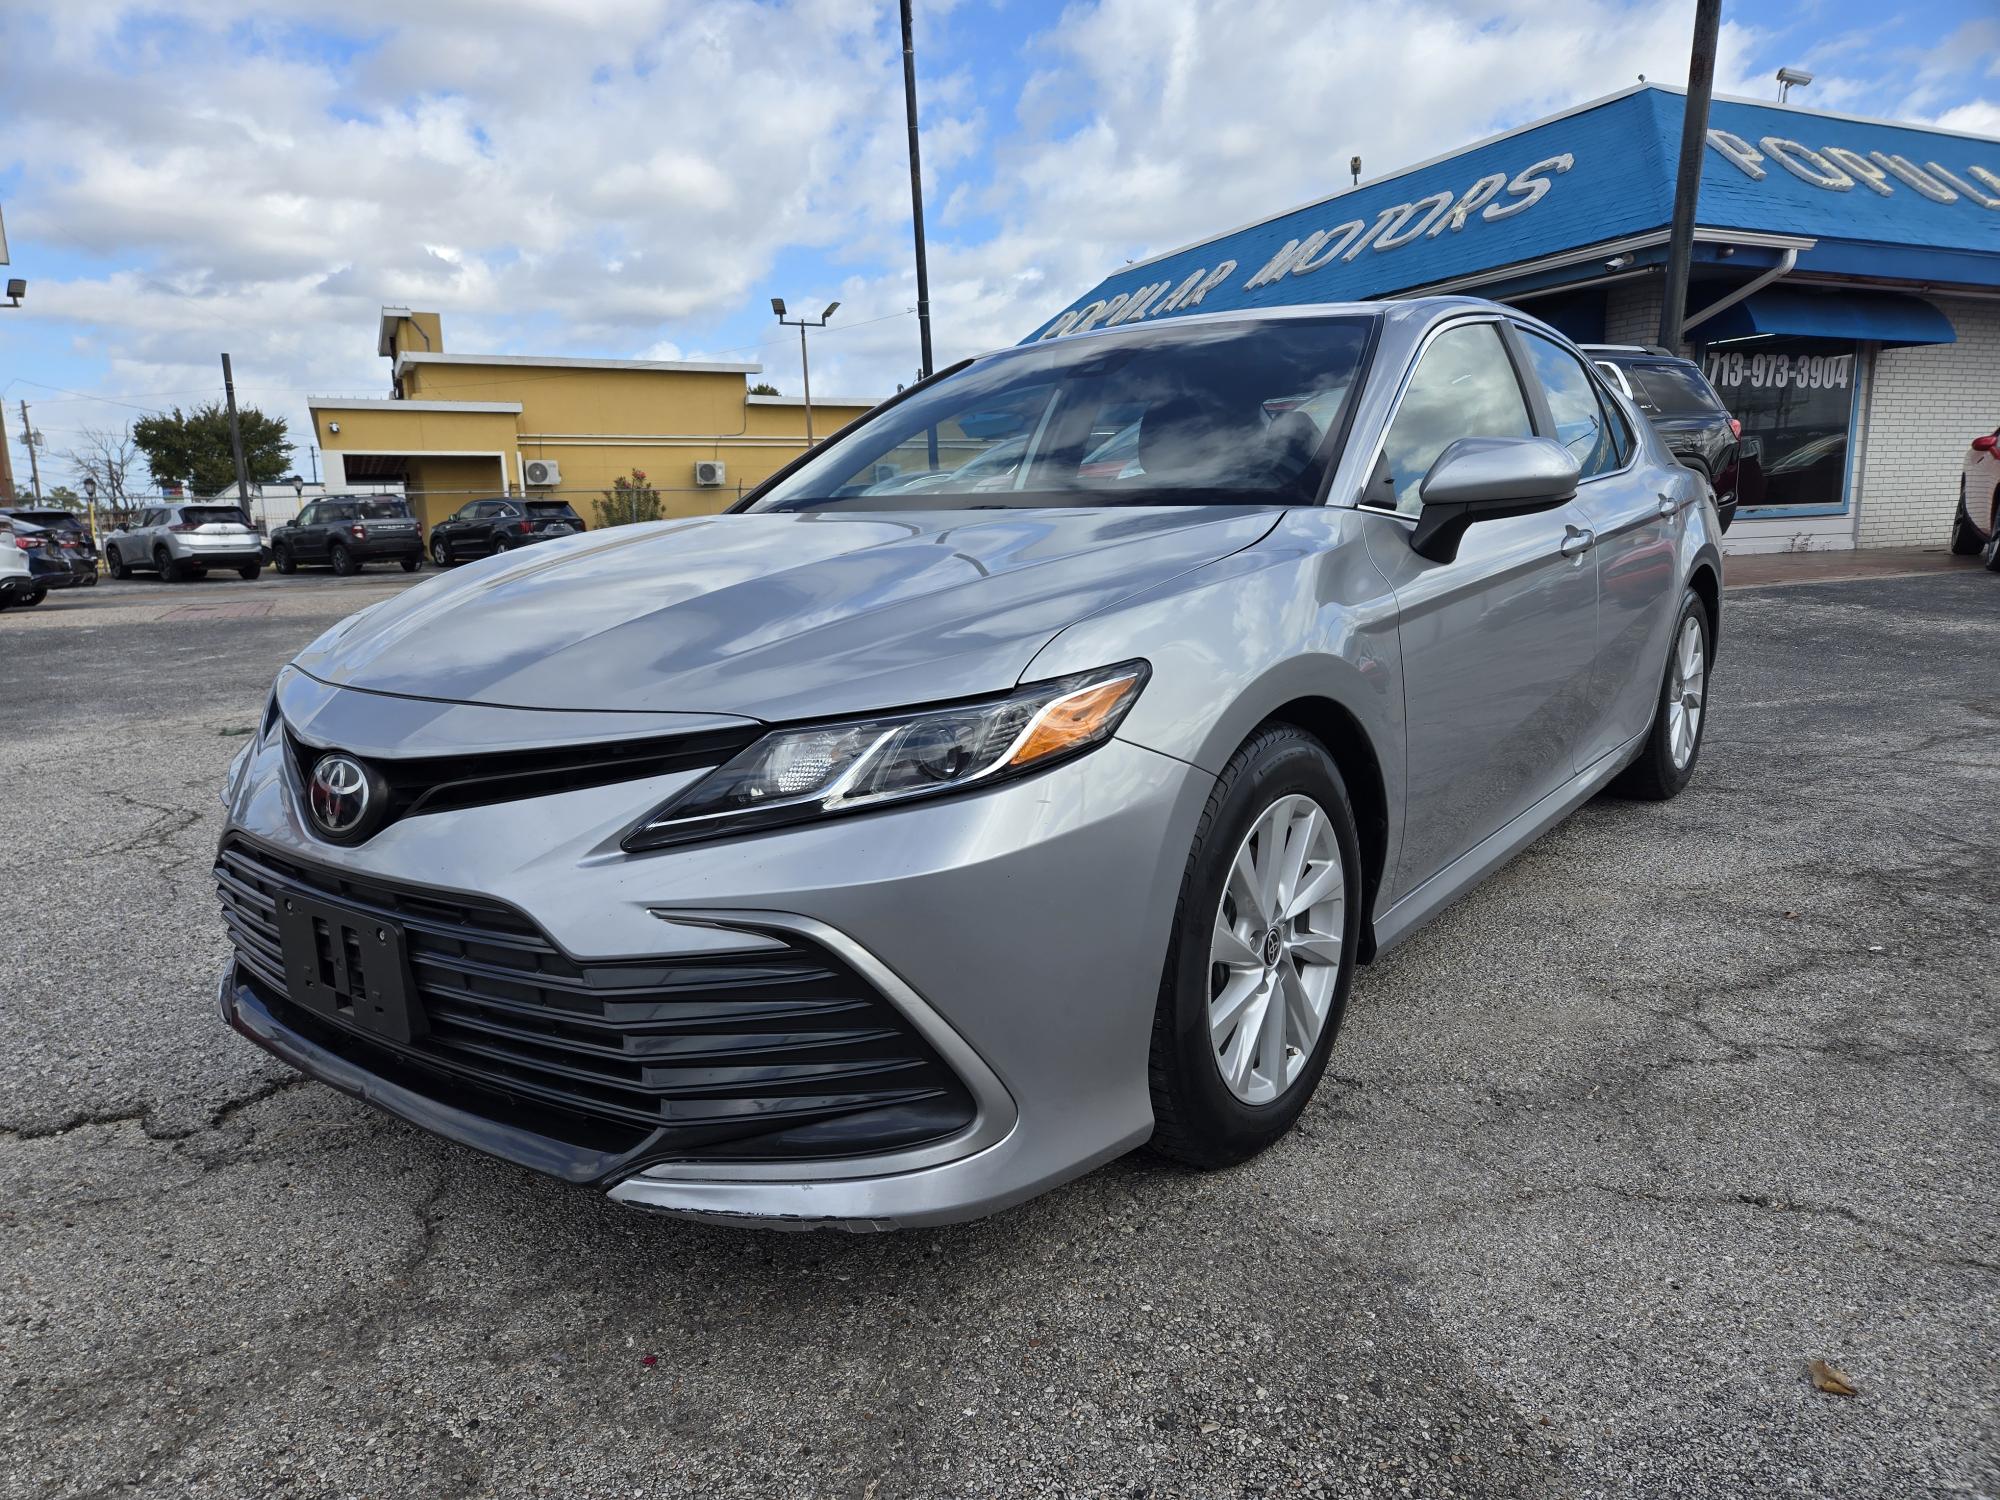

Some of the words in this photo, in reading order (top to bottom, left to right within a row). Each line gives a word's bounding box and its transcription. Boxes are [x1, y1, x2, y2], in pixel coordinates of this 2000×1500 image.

[1038, 260, 1238, 341] POPULAR
[1243, 153, 1574, 291] MOTORS
[1709, 352, 1848, 389] 713-973-3904
